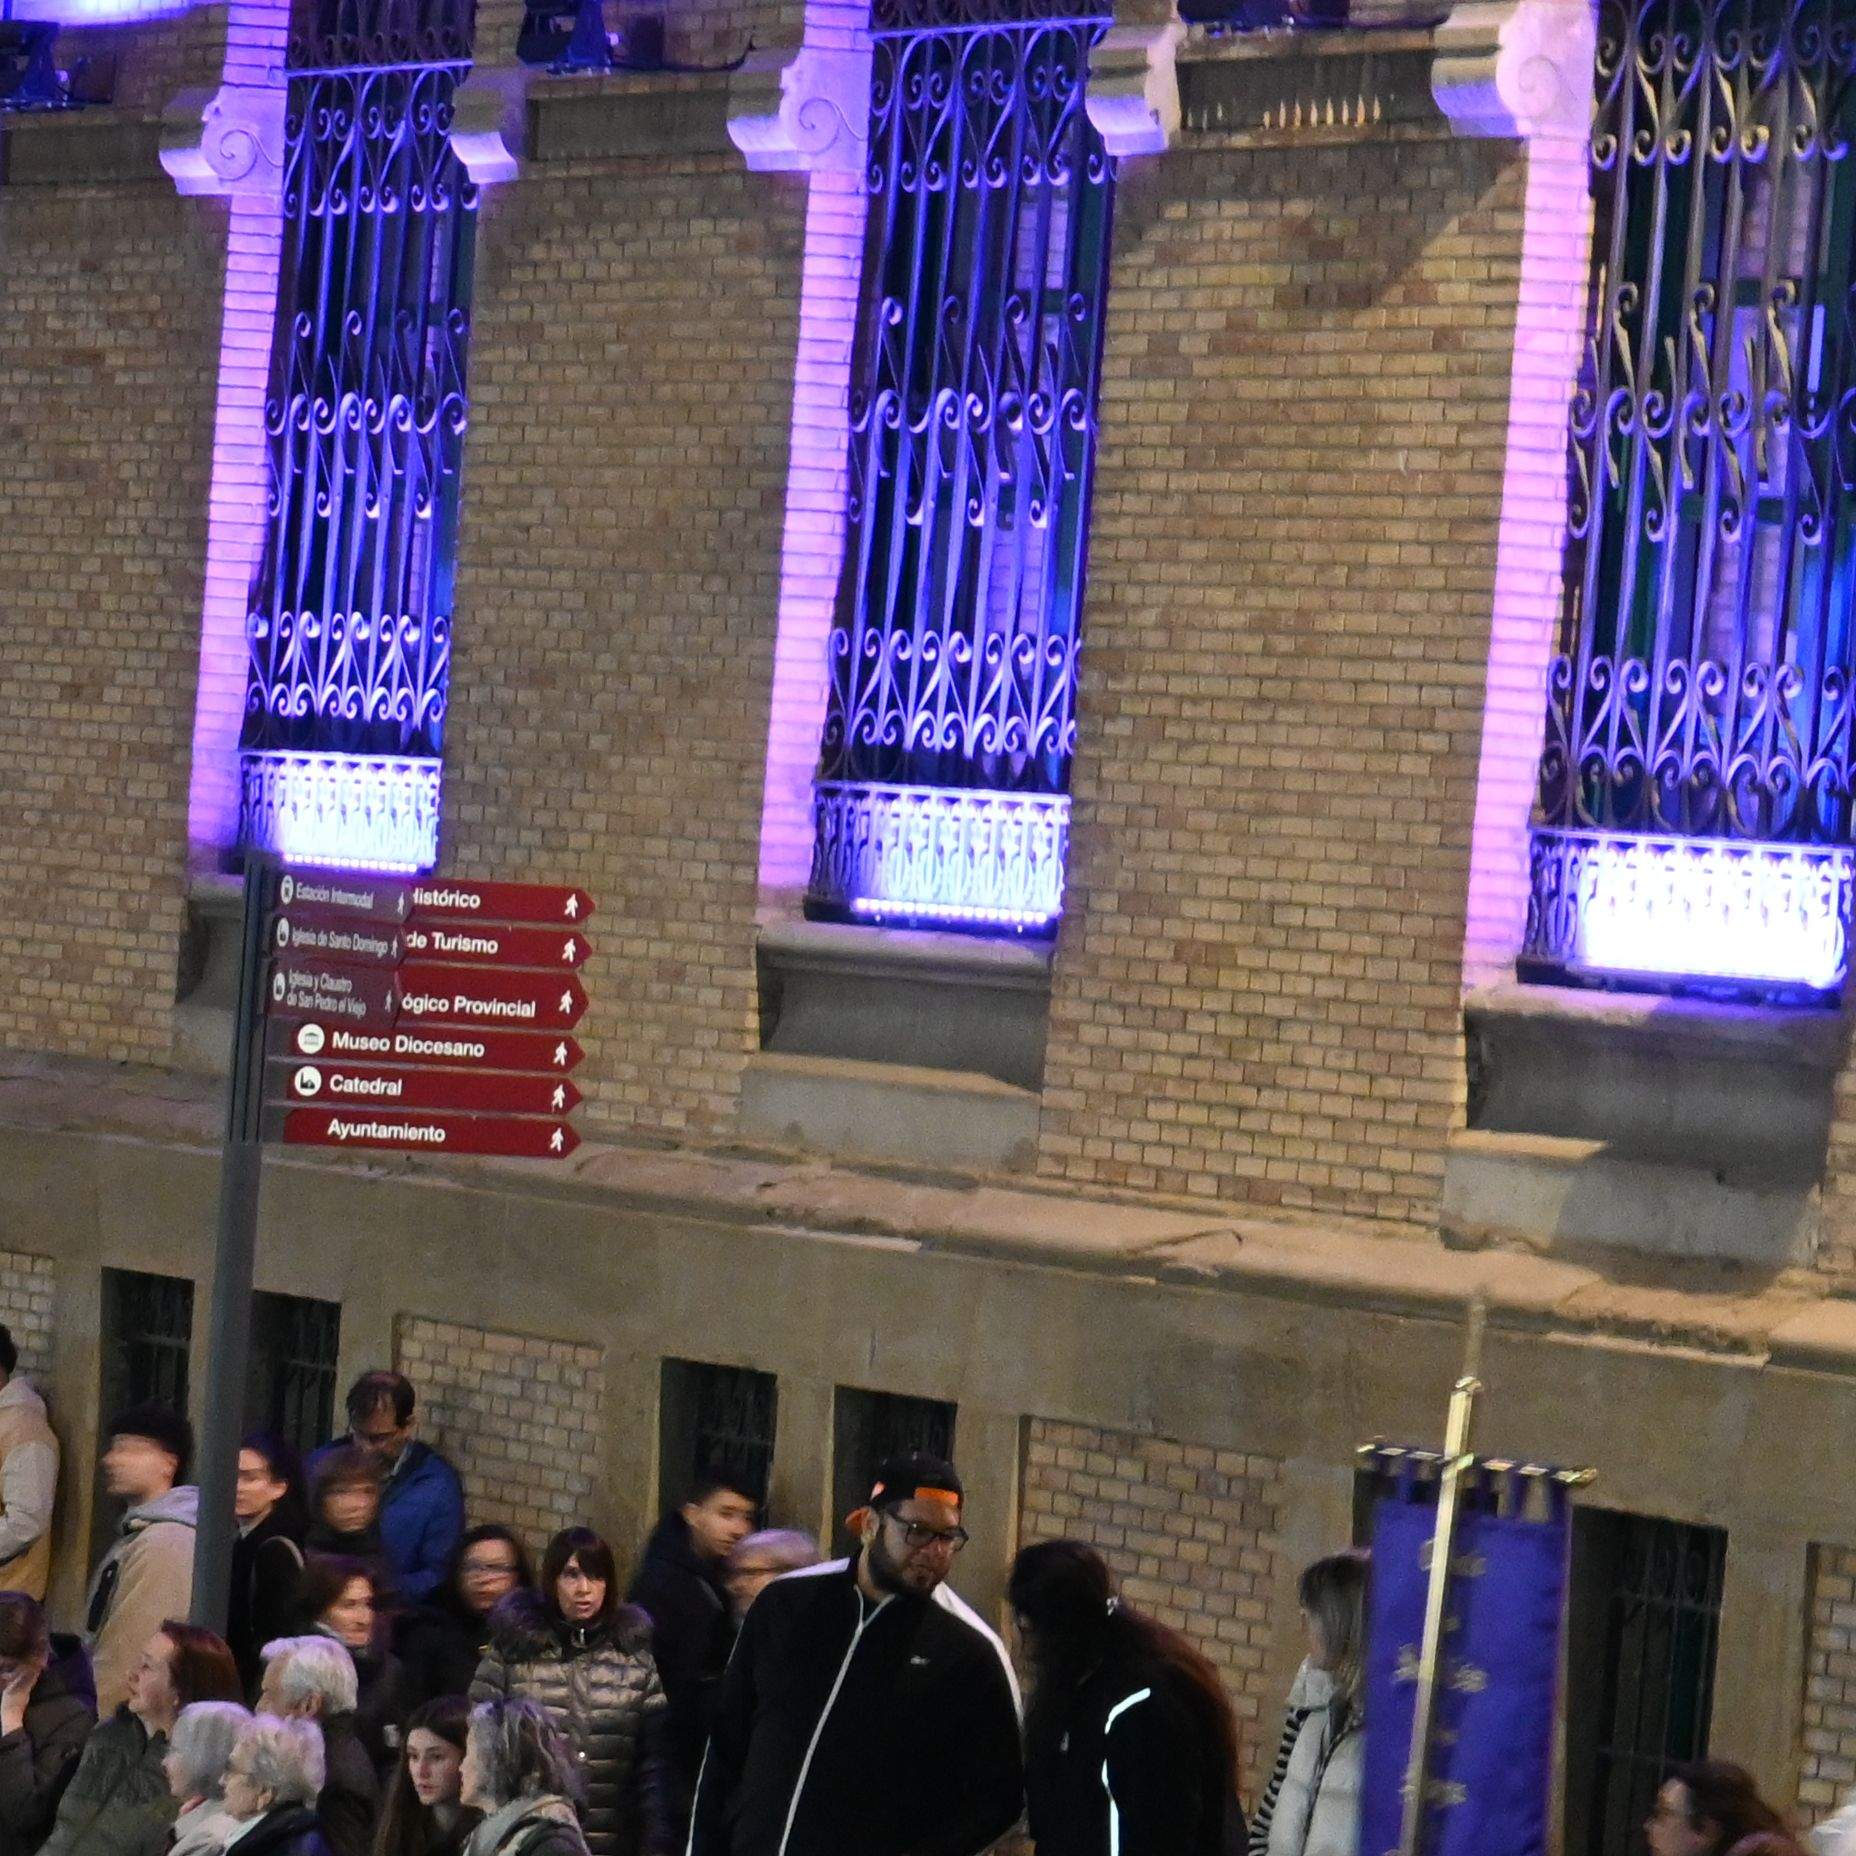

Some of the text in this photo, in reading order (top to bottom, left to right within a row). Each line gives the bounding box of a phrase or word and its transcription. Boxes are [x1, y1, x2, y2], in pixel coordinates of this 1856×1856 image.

[296, 882, 374, 909] Estación Intermodal
[292, 926, 388, 958] Iglesia de Santo Domingo
[406, 931, 499, 954] de Turismo
[289, 968, 313, 989] Iglesia
[314, 975, 319, 992] y
[287, 990, 366, 1019] de San Pedro el Viejo
[454, 995, 536, 1018] Provincial
[332, 1031, 485, 1058] Museo Diocesano
[330, 1074, 402, 1096] Catedral
[327, 1118, 446, 1142] Ayuntamiento
